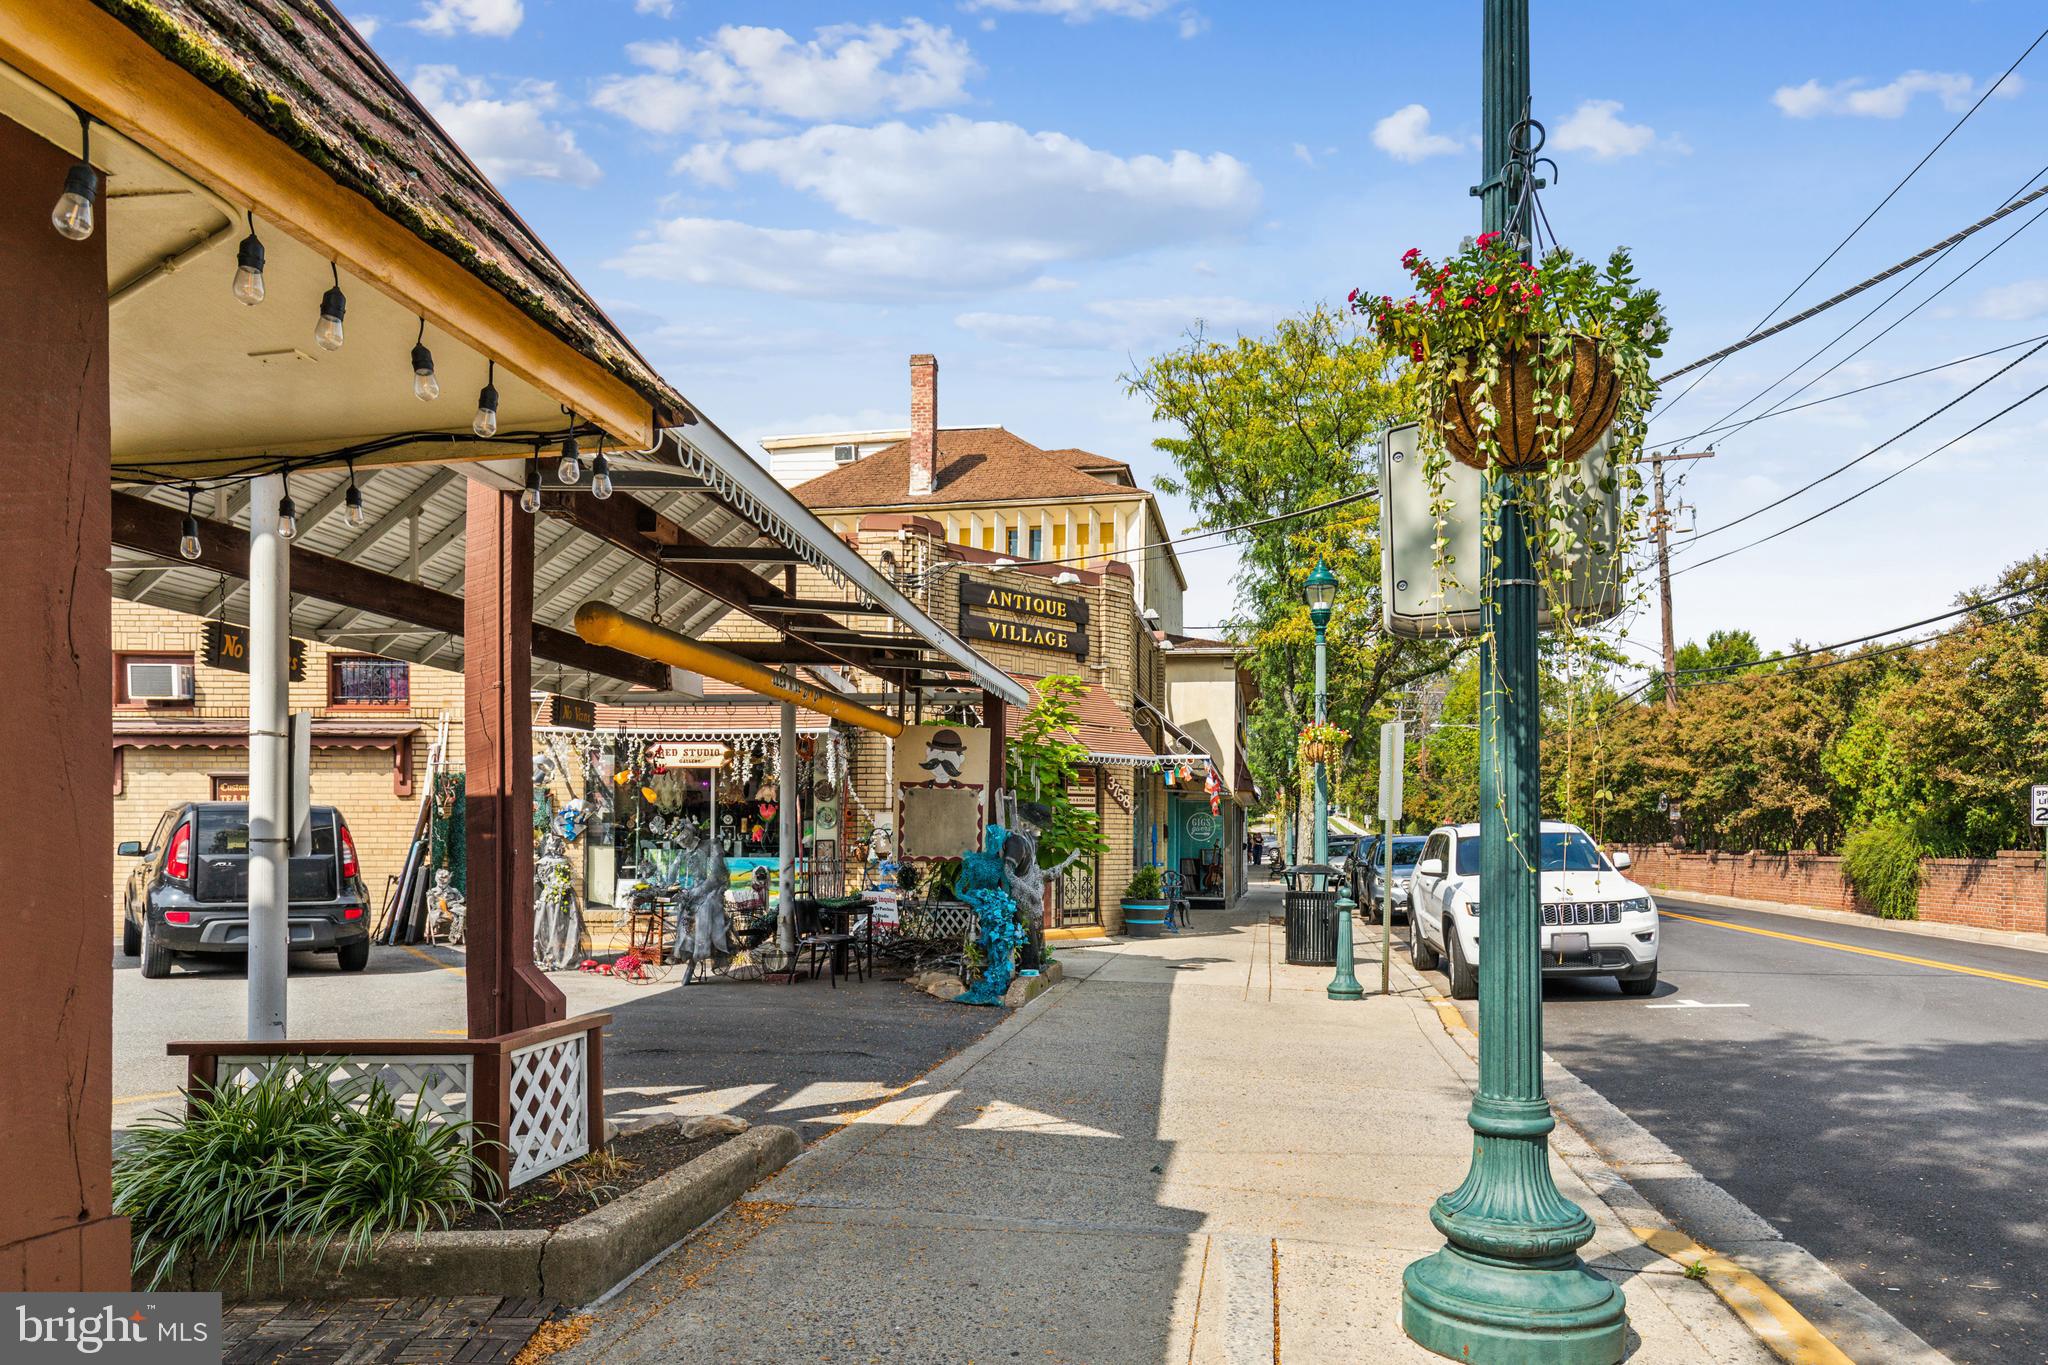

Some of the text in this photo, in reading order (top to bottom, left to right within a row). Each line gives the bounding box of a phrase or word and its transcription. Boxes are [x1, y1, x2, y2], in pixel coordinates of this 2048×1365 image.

[987, 589, 1067, 617] ANTIQUE
[222, 634, 243, 658] No
[987, 621, 1068, 649] VILLAGE
[683, 748, 721, 757] STUDIO
[1107, 776, 1131, 809] 3758
